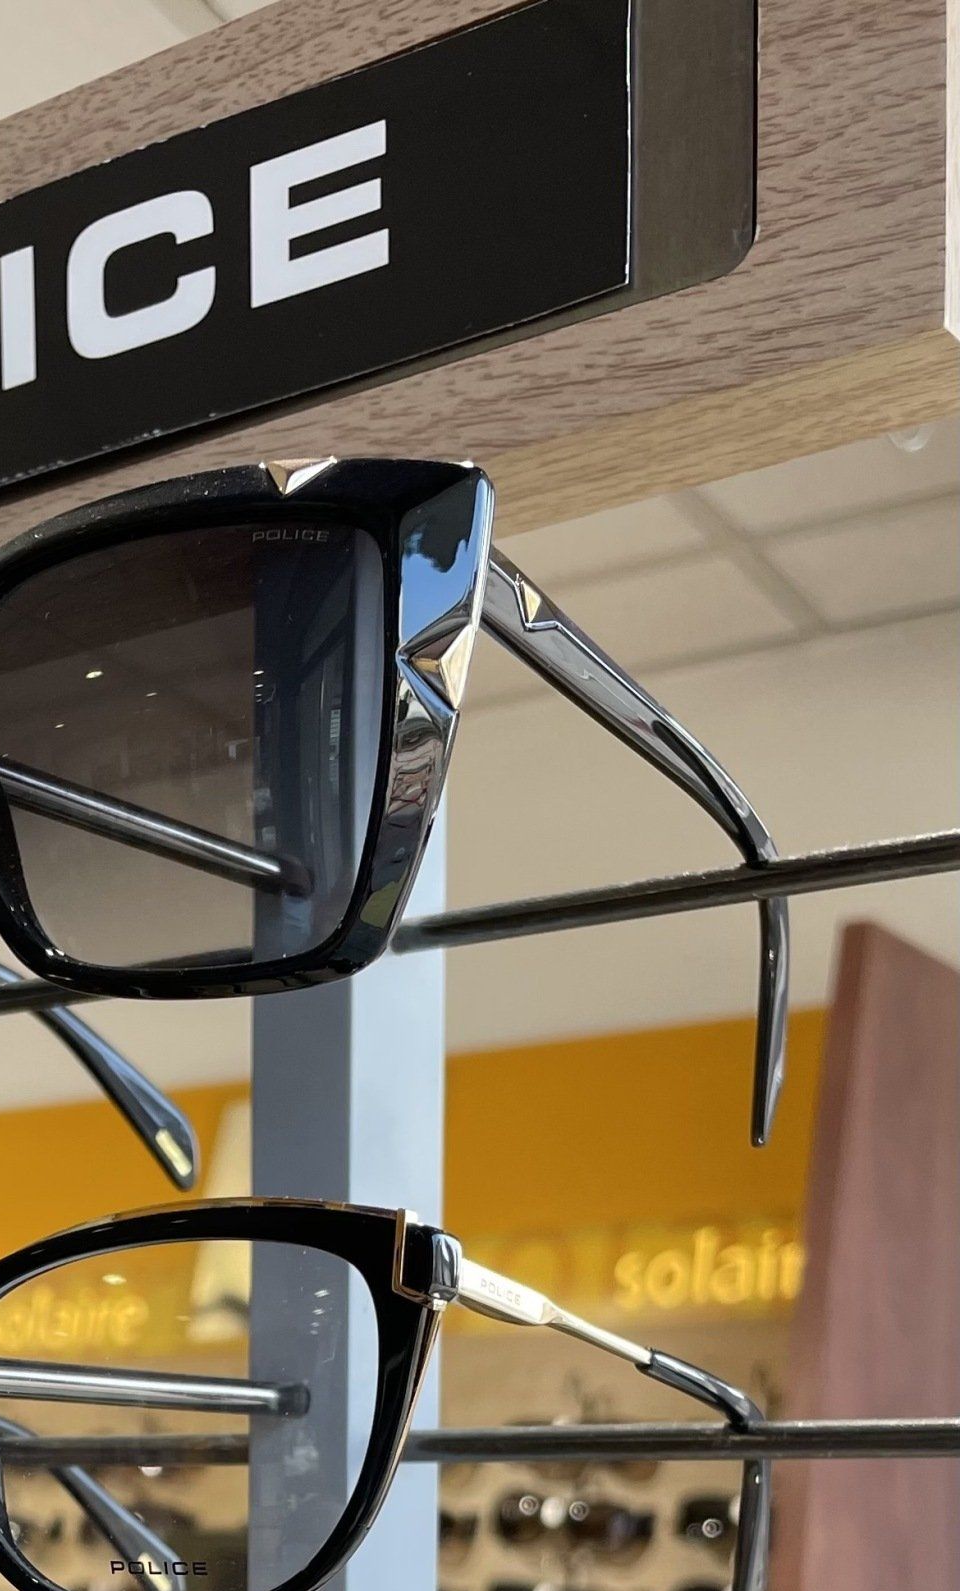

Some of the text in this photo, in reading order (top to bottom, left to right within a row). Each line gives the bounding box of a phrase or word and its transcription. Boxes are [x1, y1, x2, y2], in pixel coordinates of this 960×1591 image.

[252, 529, 329, 543] POLICE
[480, 1277, 522, 1306] POLICE
[110, 1561, 208, 1575] POLICE
